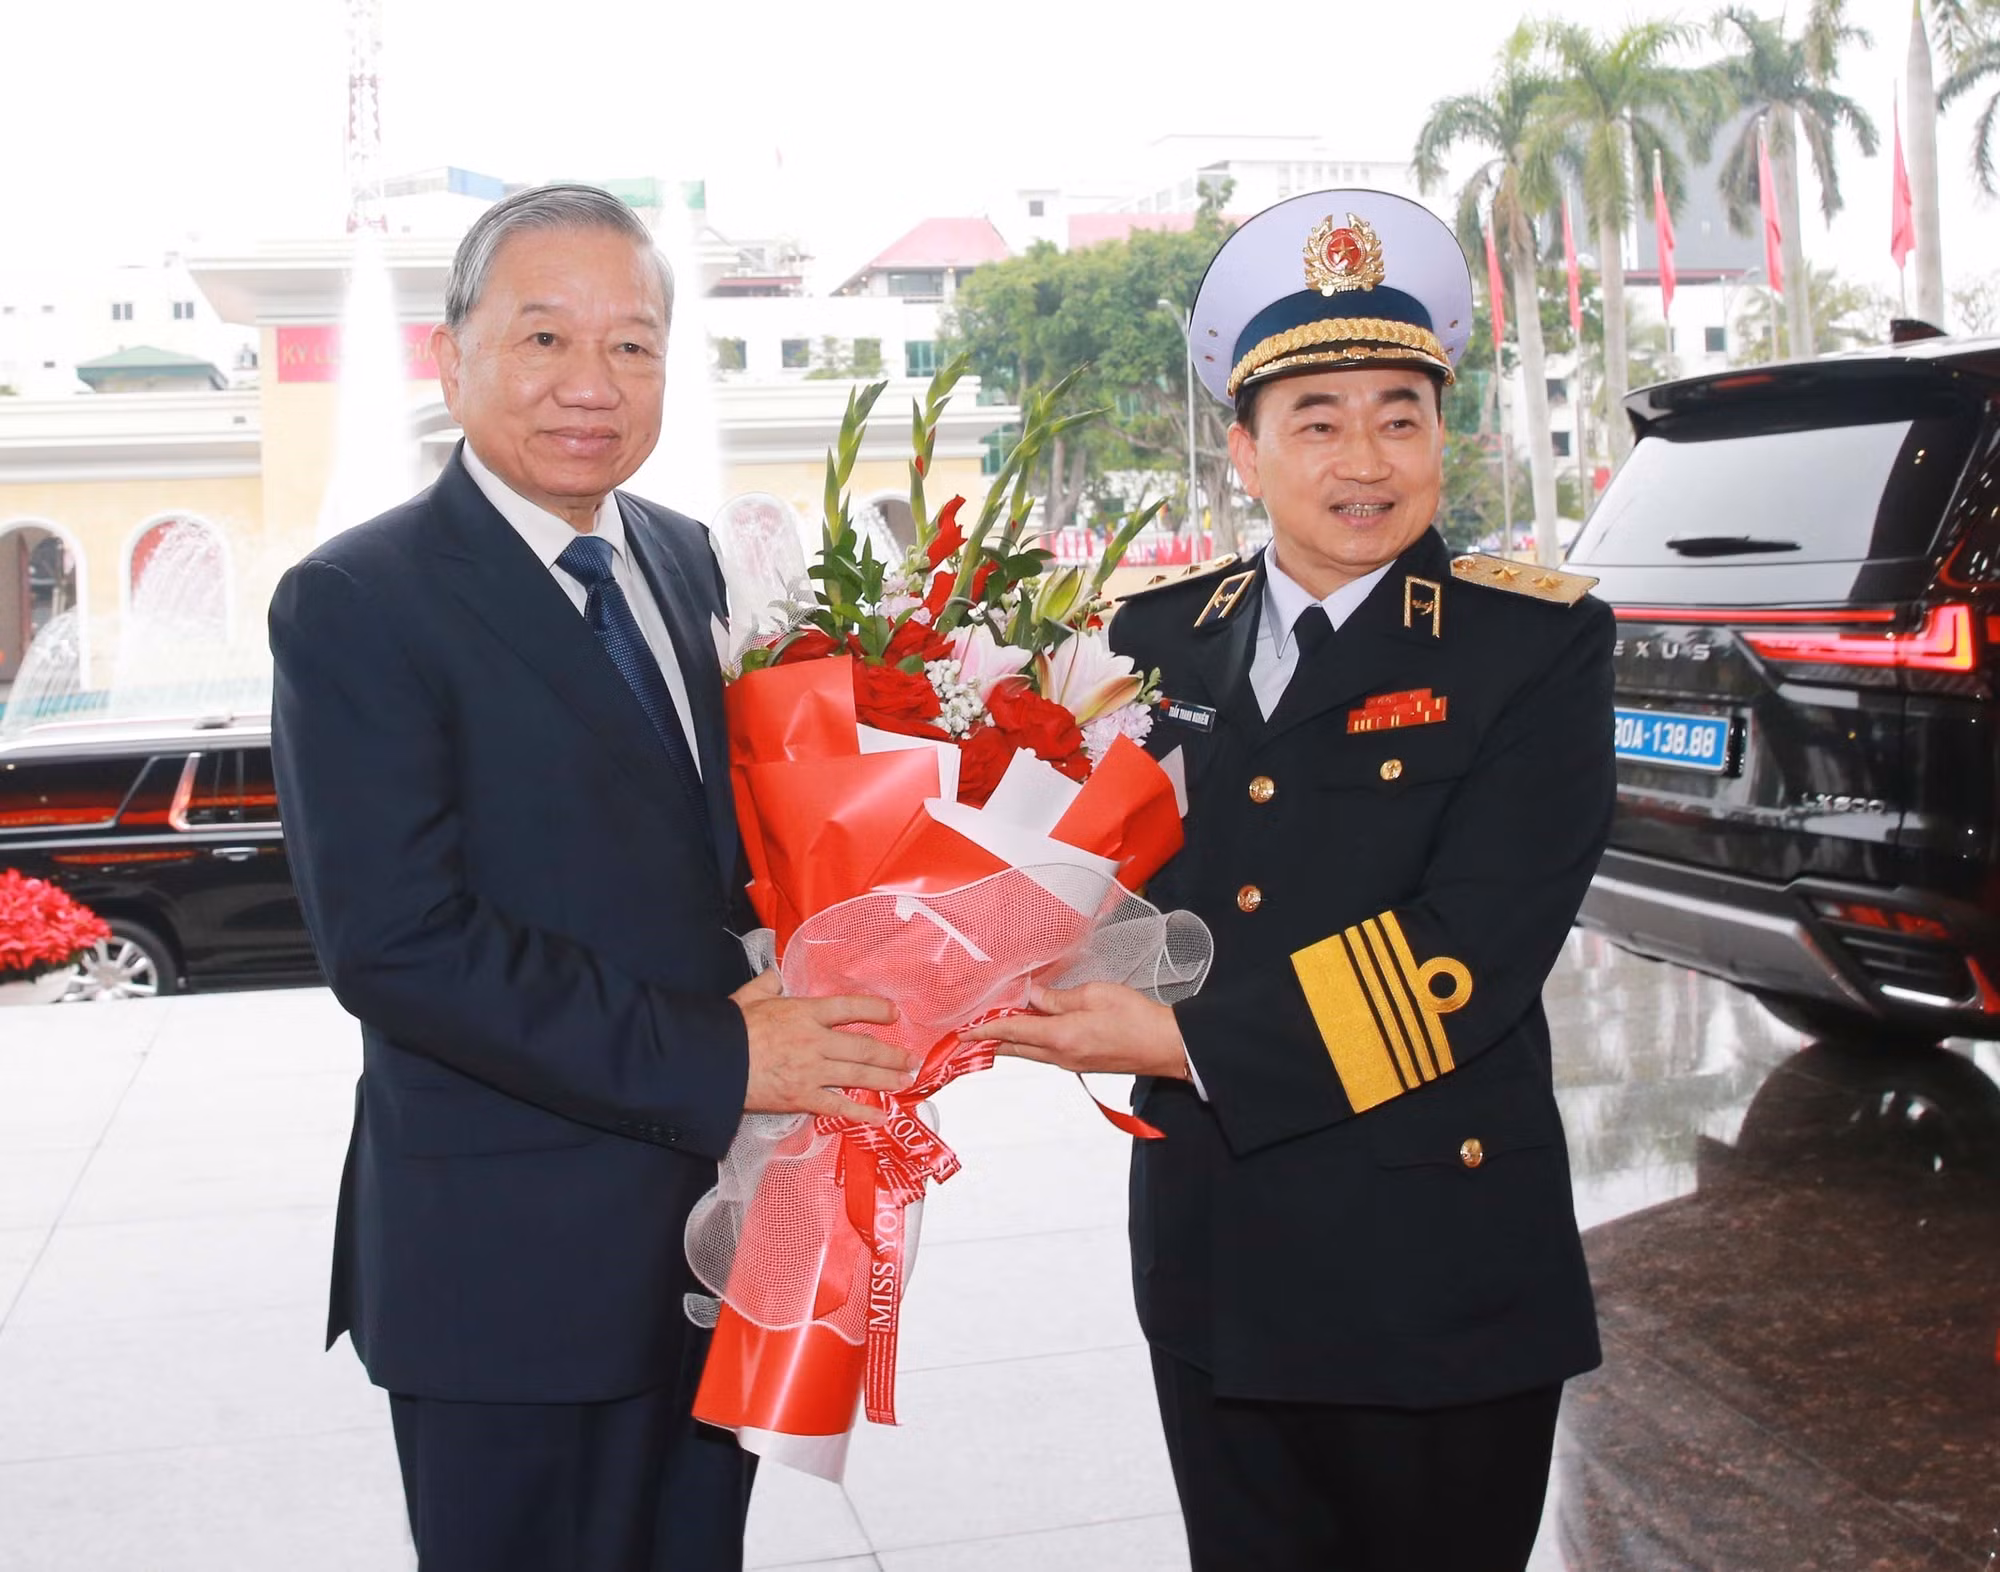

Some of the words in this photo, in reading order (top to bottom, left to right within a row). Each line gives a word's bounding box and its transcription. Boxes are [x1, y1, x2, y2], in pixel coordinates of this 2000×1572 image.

[1613, 639, 1711, 661] EXUS
[888, 1104, 936, 1150] YOU
[869, 1262, 896, 1328] MISS
